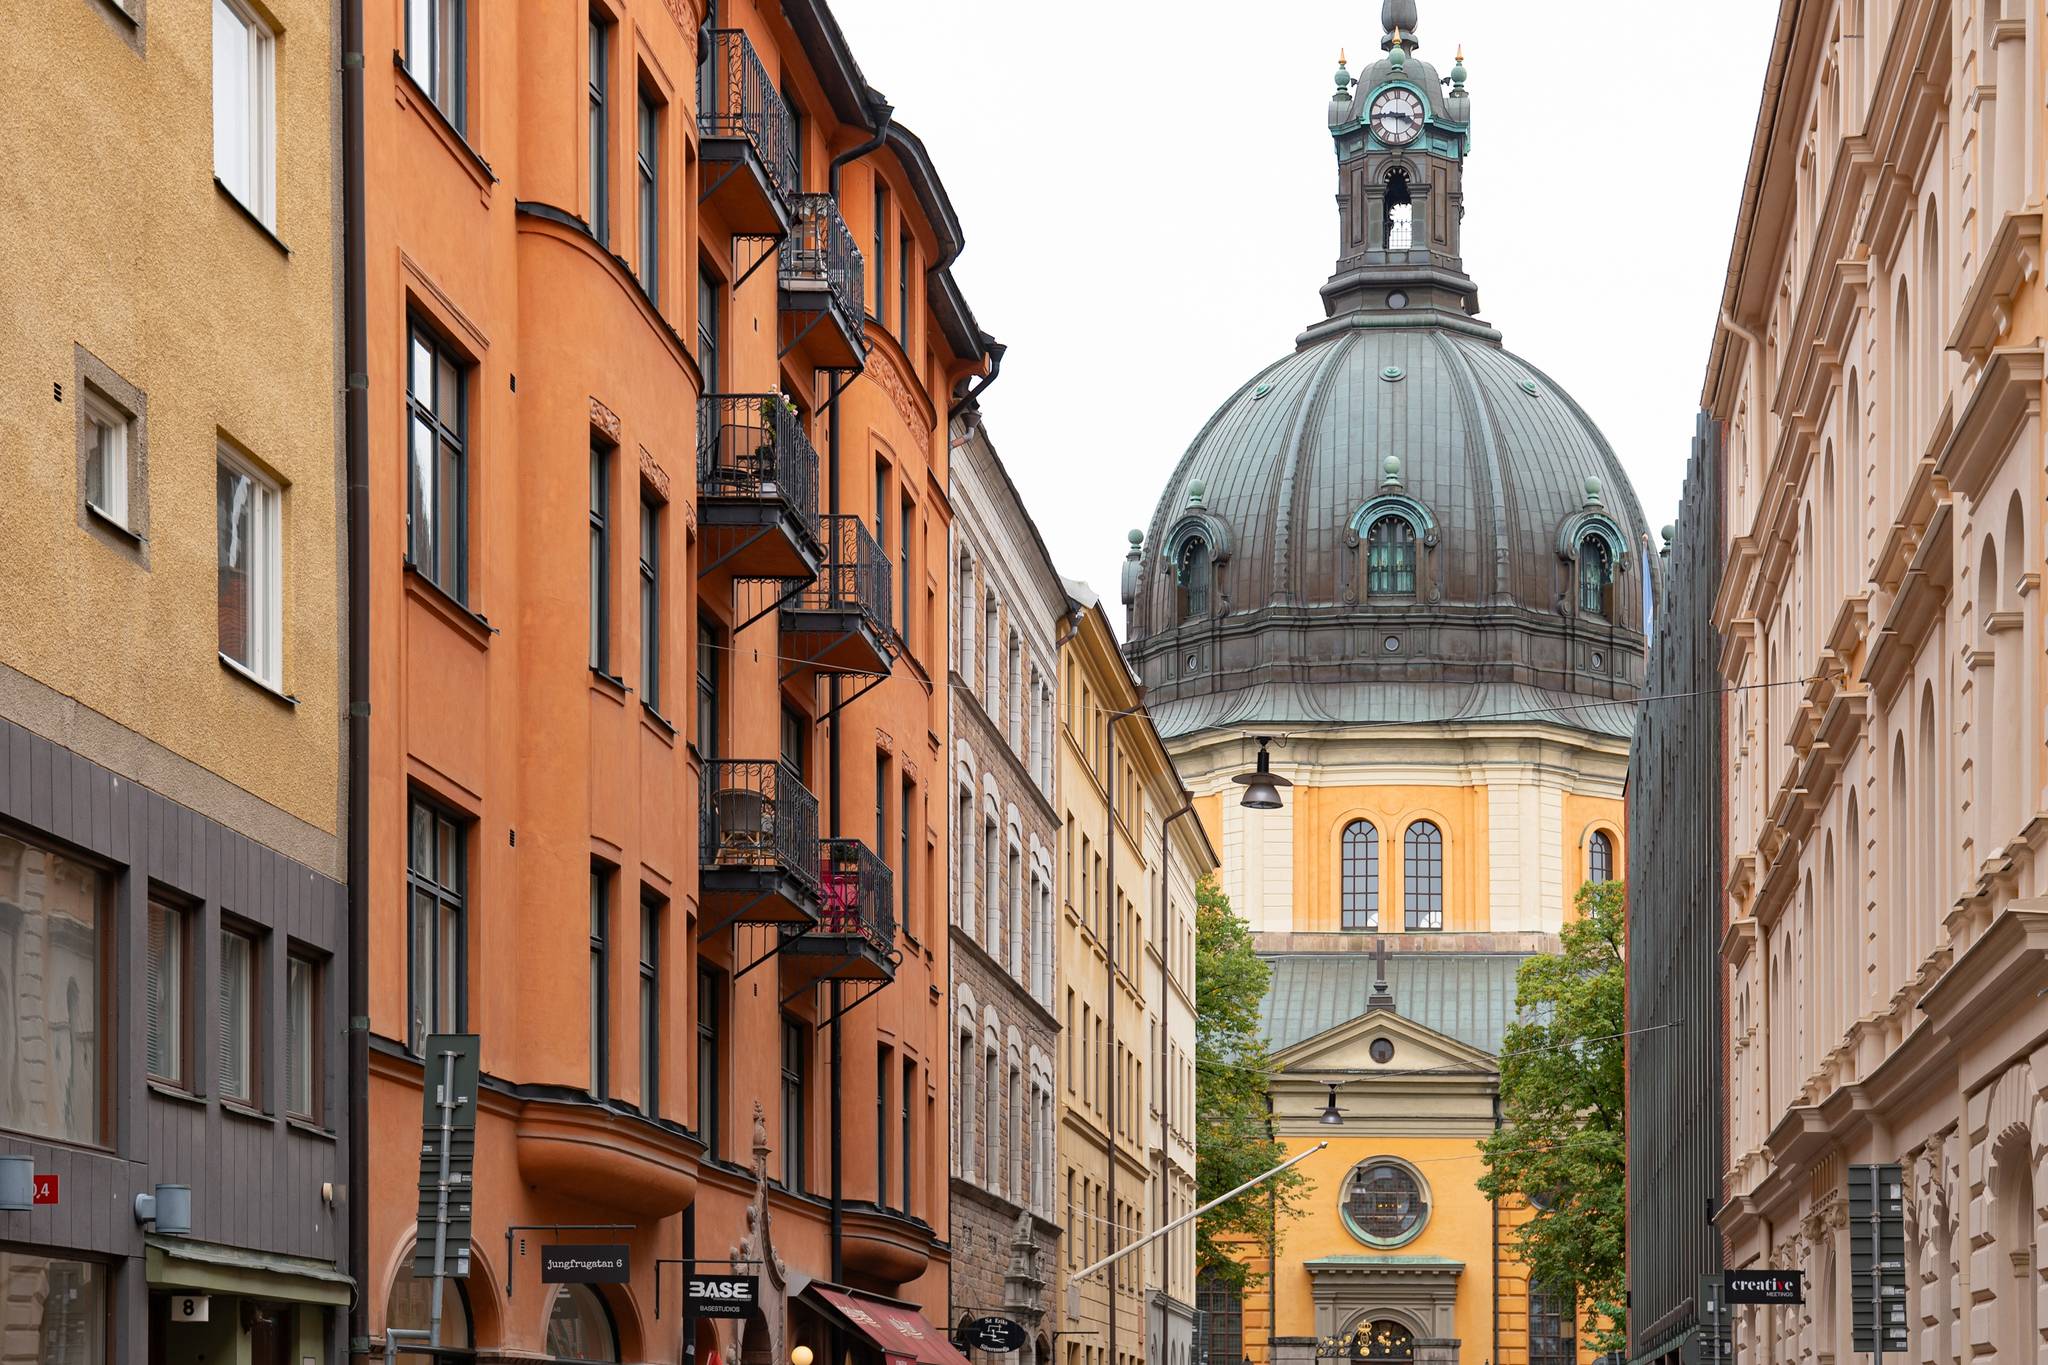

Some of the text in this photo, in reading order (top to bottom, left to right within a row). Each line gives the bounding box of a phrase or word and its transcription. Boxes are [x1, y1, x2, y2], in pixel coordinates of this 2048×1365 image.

[547, 1259, 623, 1270] jungfrugatan 6
[1731, 1277, 1794, 1291] creative
[183, 1299, 195, 1316] 8
